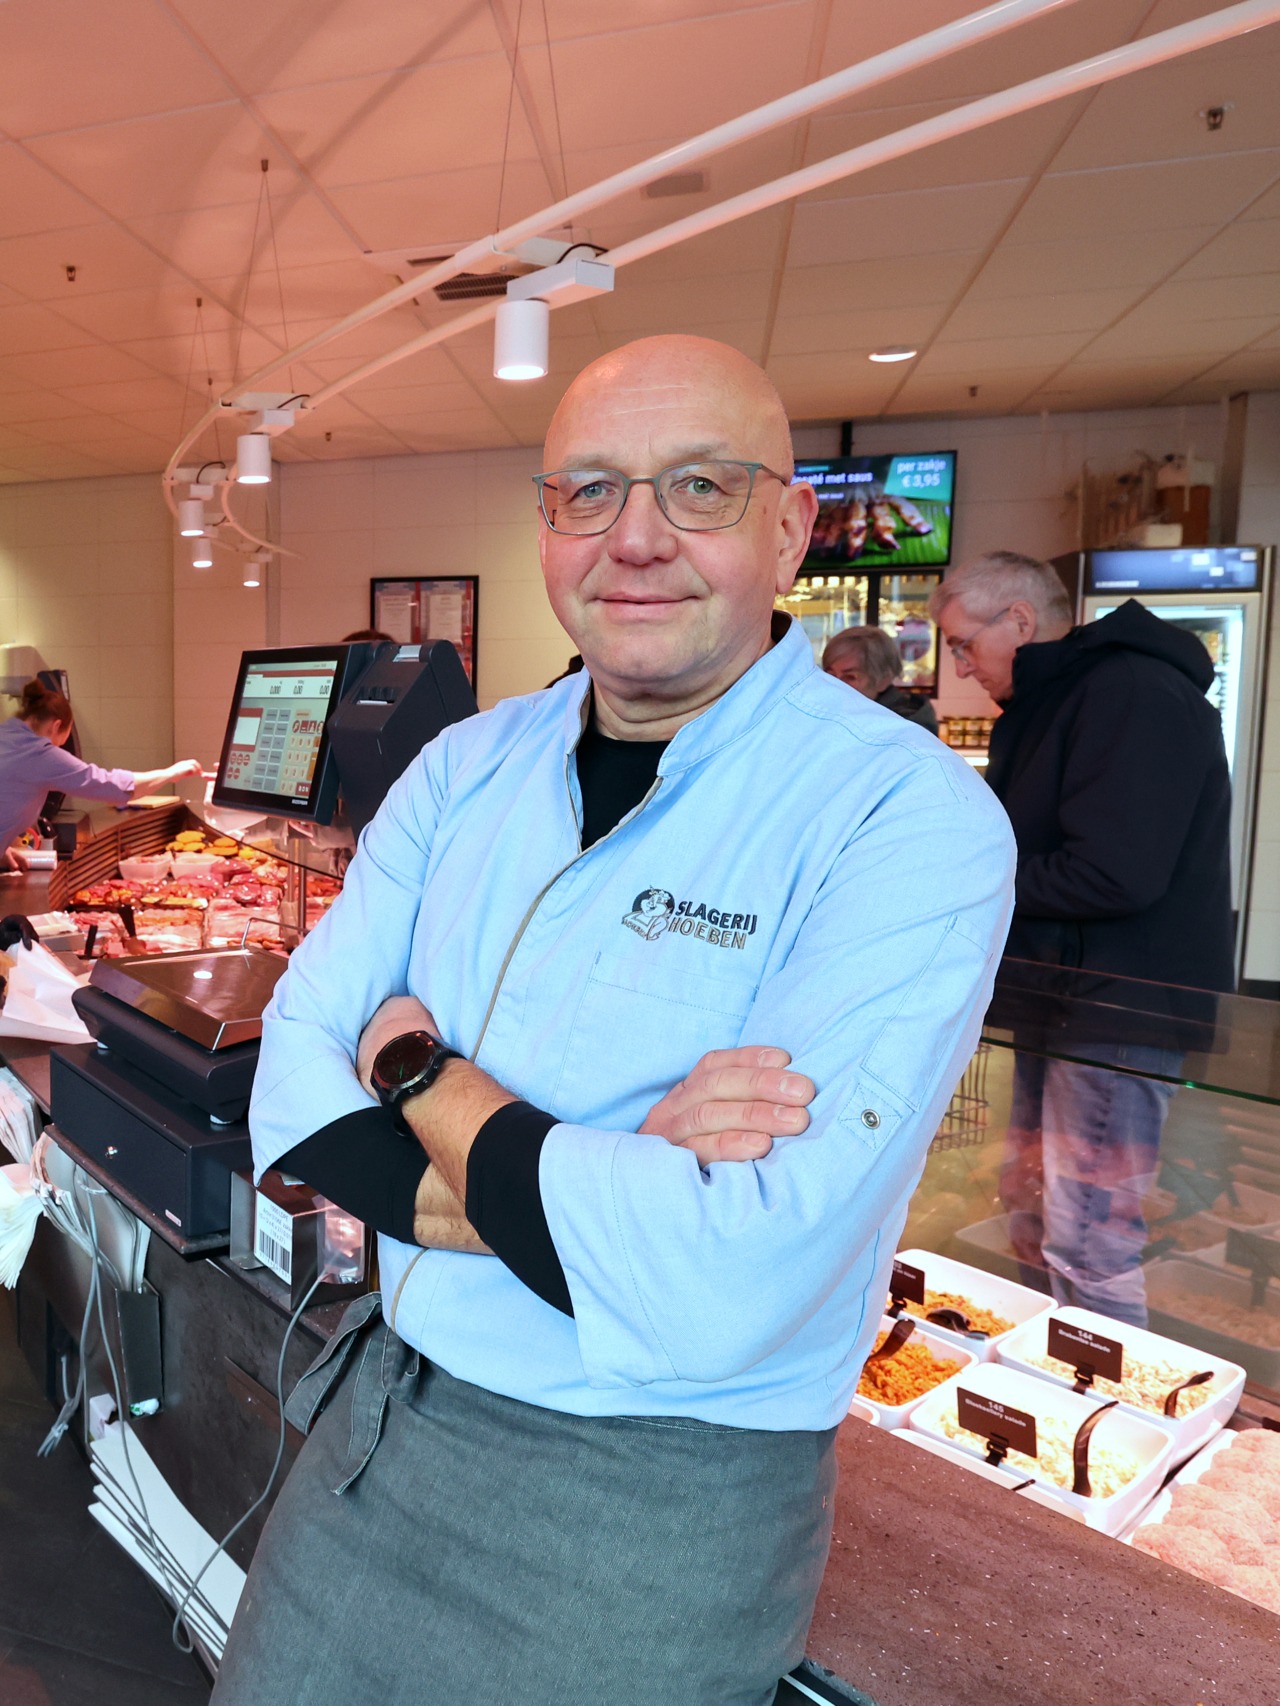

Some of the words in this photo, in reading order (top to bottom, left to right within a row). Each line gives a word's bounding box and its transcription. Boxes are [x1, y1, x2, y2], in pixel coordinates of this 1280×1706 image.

[825, 473, 846, 485] met
[847, 472, 873, 484] saus
[668, 917, 747, 950] HOEBEN
[675, 901, 758, 935] SLAGERIJ
